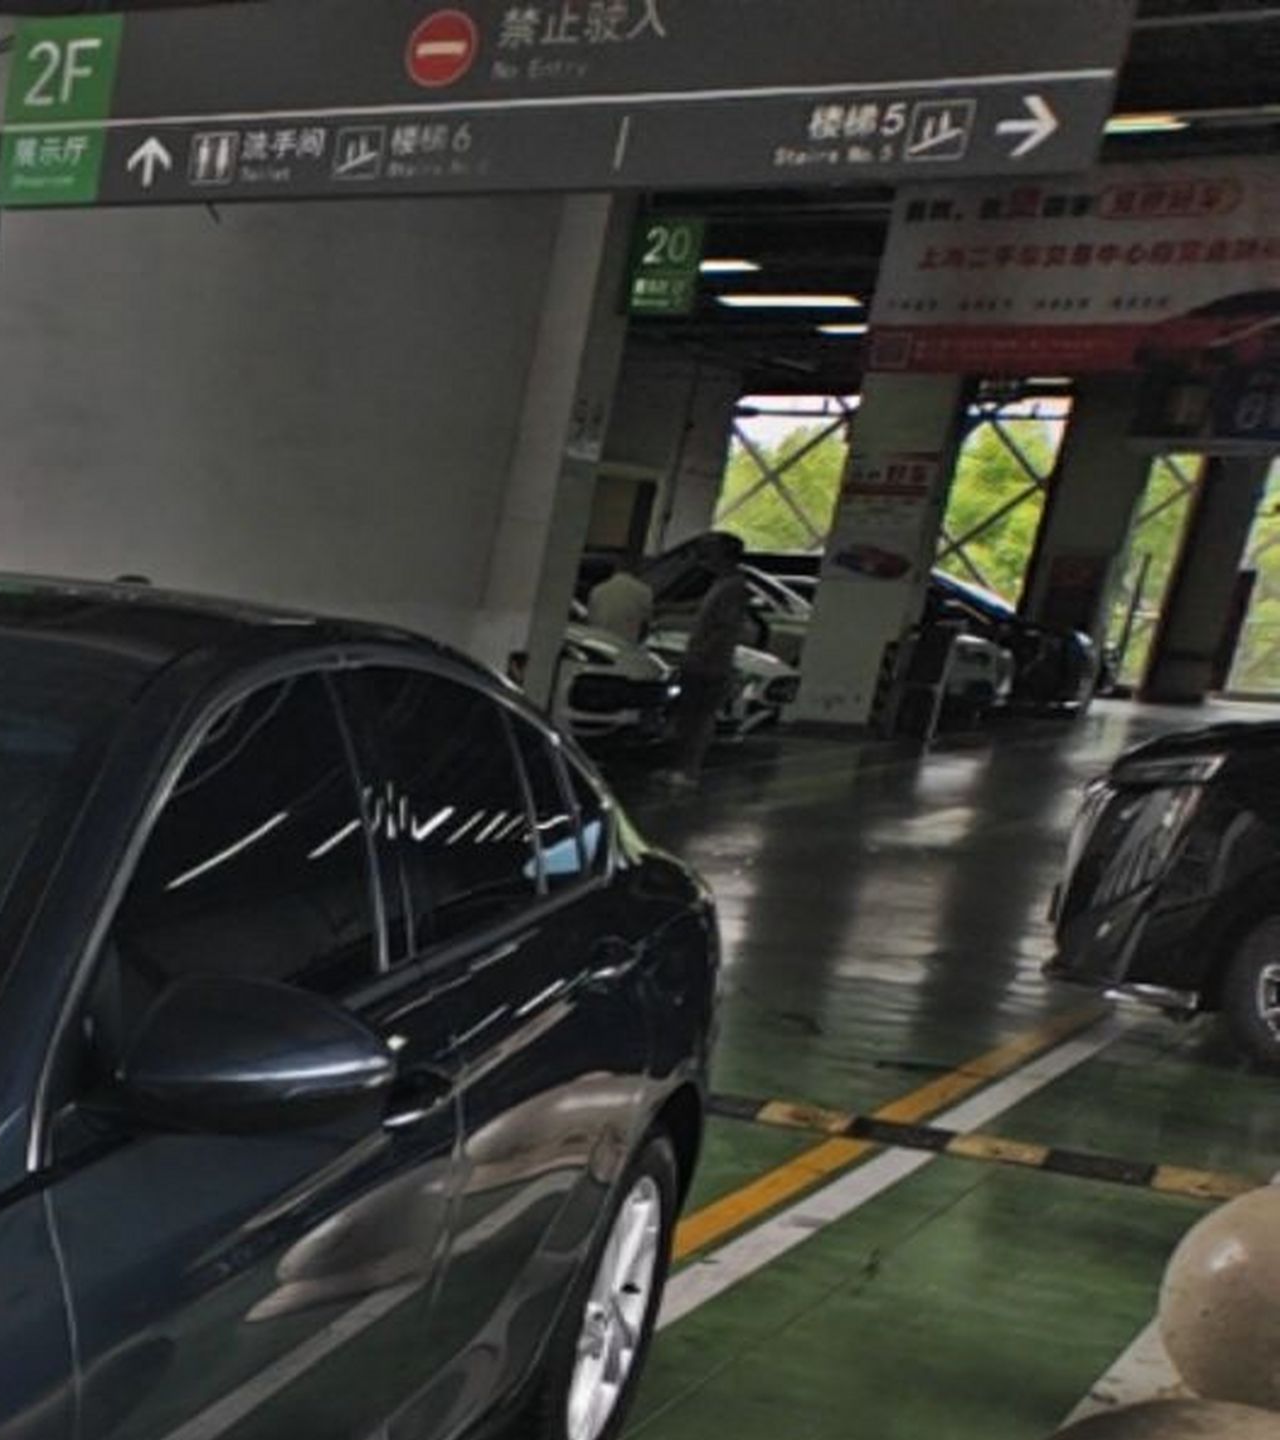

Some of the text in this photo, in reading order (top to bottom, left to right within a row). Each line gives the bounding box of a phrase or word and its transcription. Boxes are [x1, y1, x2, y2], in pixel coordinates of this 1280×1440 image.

[496, 0, 667, 49] 禁止驶入
[22, 37, 102, 106] 2F
[241, 127, 326, 160] 洗手间
[641, 226, 692, 264] 20
